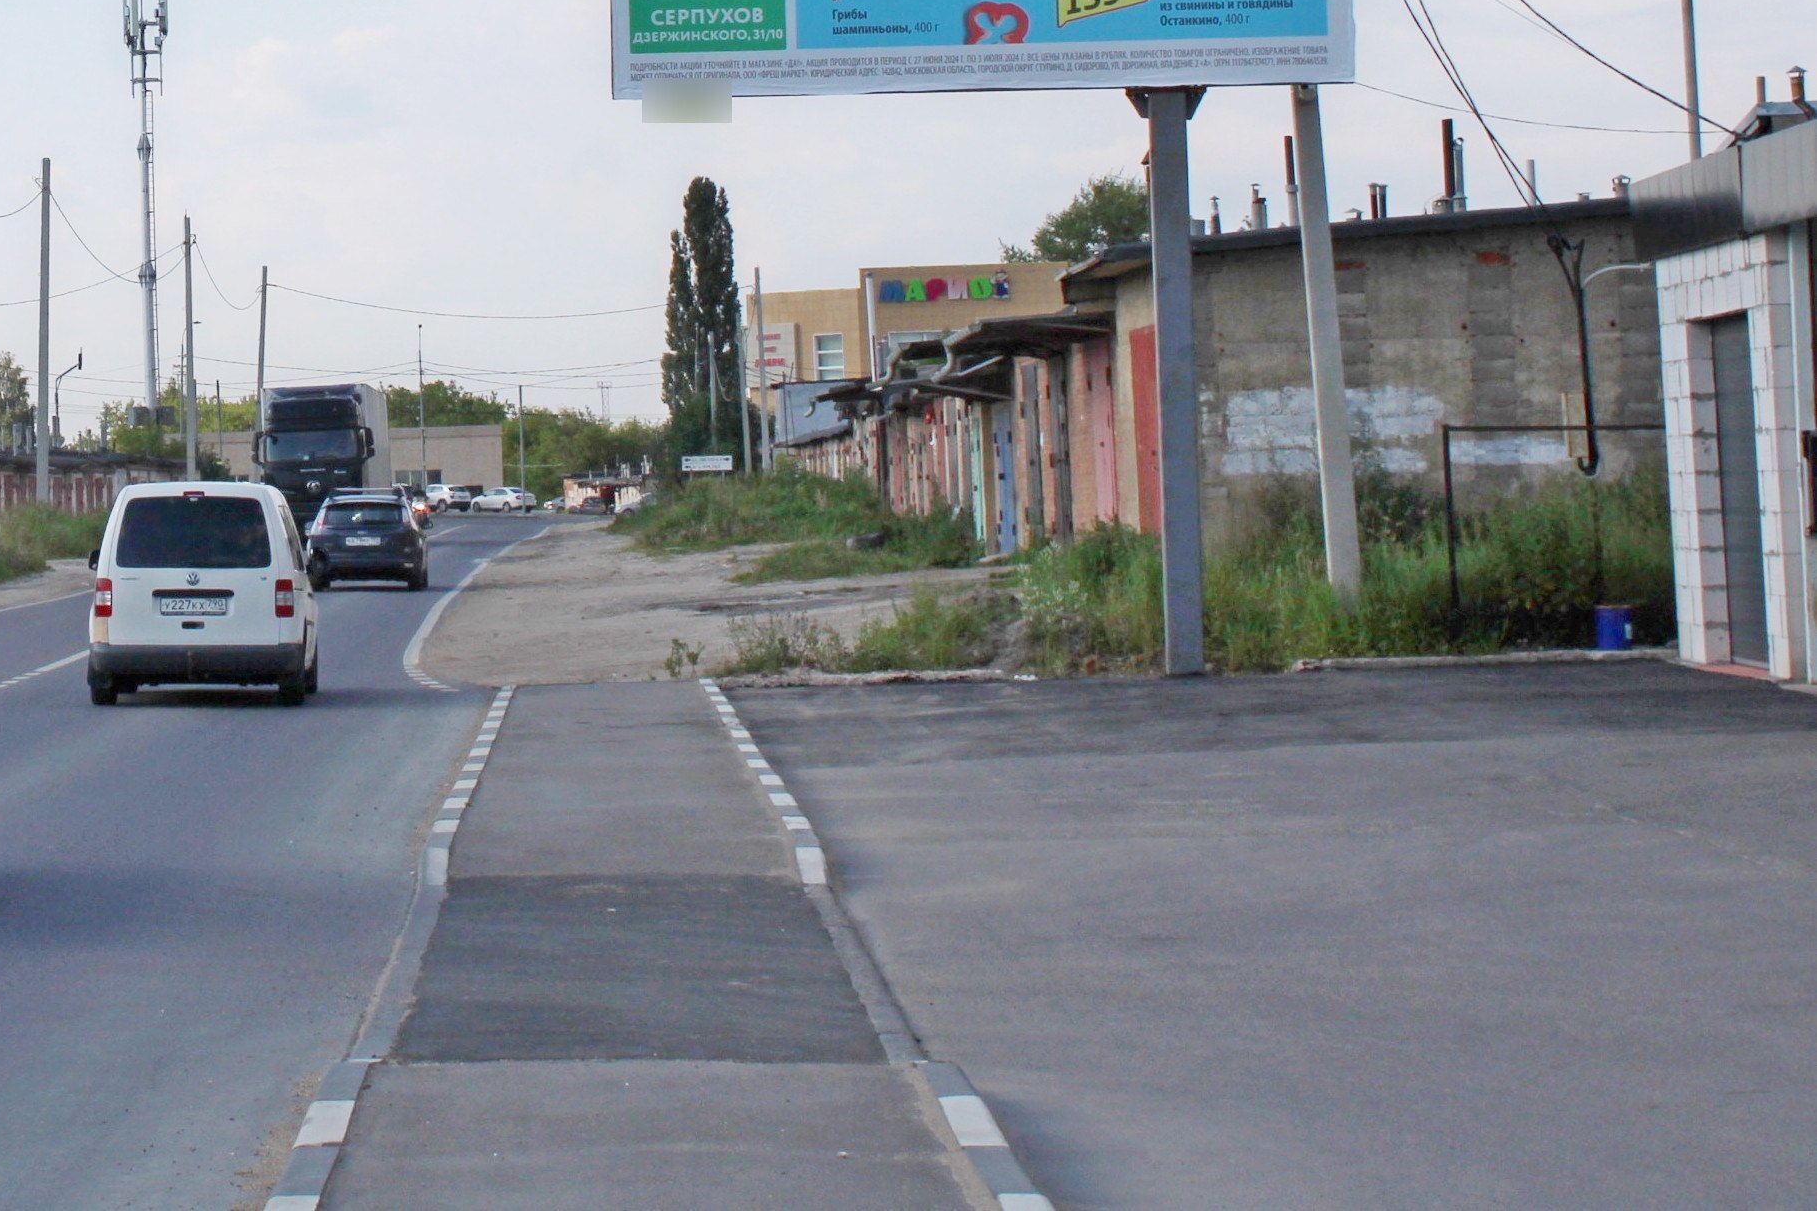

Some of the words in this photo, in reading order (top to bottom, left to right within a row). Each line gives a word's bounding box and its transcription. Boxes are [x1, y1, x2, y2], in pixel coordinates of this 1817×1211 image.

[1159, 1, 1173, 12] из
[1174, 0, 1225, 11] свинины
[1227, 0, 1234, 10] и
[650, 7, 764, 26] СЕРПУХОВ
[832, 8, 867, 23] Грибы
[1160, 14, 1222, 27] Останкино,
[1225, 13, 1244, 25] 400
[632, 29, 751, 44] ДЗЕРЖИНСКОГО,
[753, 29, 783, 41] 31/10
[832, 23, 911, 36] шампиньоны,
[914, 22, 932, 33] 400
[630, 61, 678, 72] ПОДРОБНОСТИ
[680, 61, 702, 71] АКЦИИ
[880, 55, 907, 66] ПЕРИОД
[1027, 52, 1039, 61] ВСЕ
[1041, 51, 1059, 62] ЦЕНЫ
[1129, 48, 1173, 58] КОЛИЧЕСТВО
[879, 276, 993, 303] МАРИО
